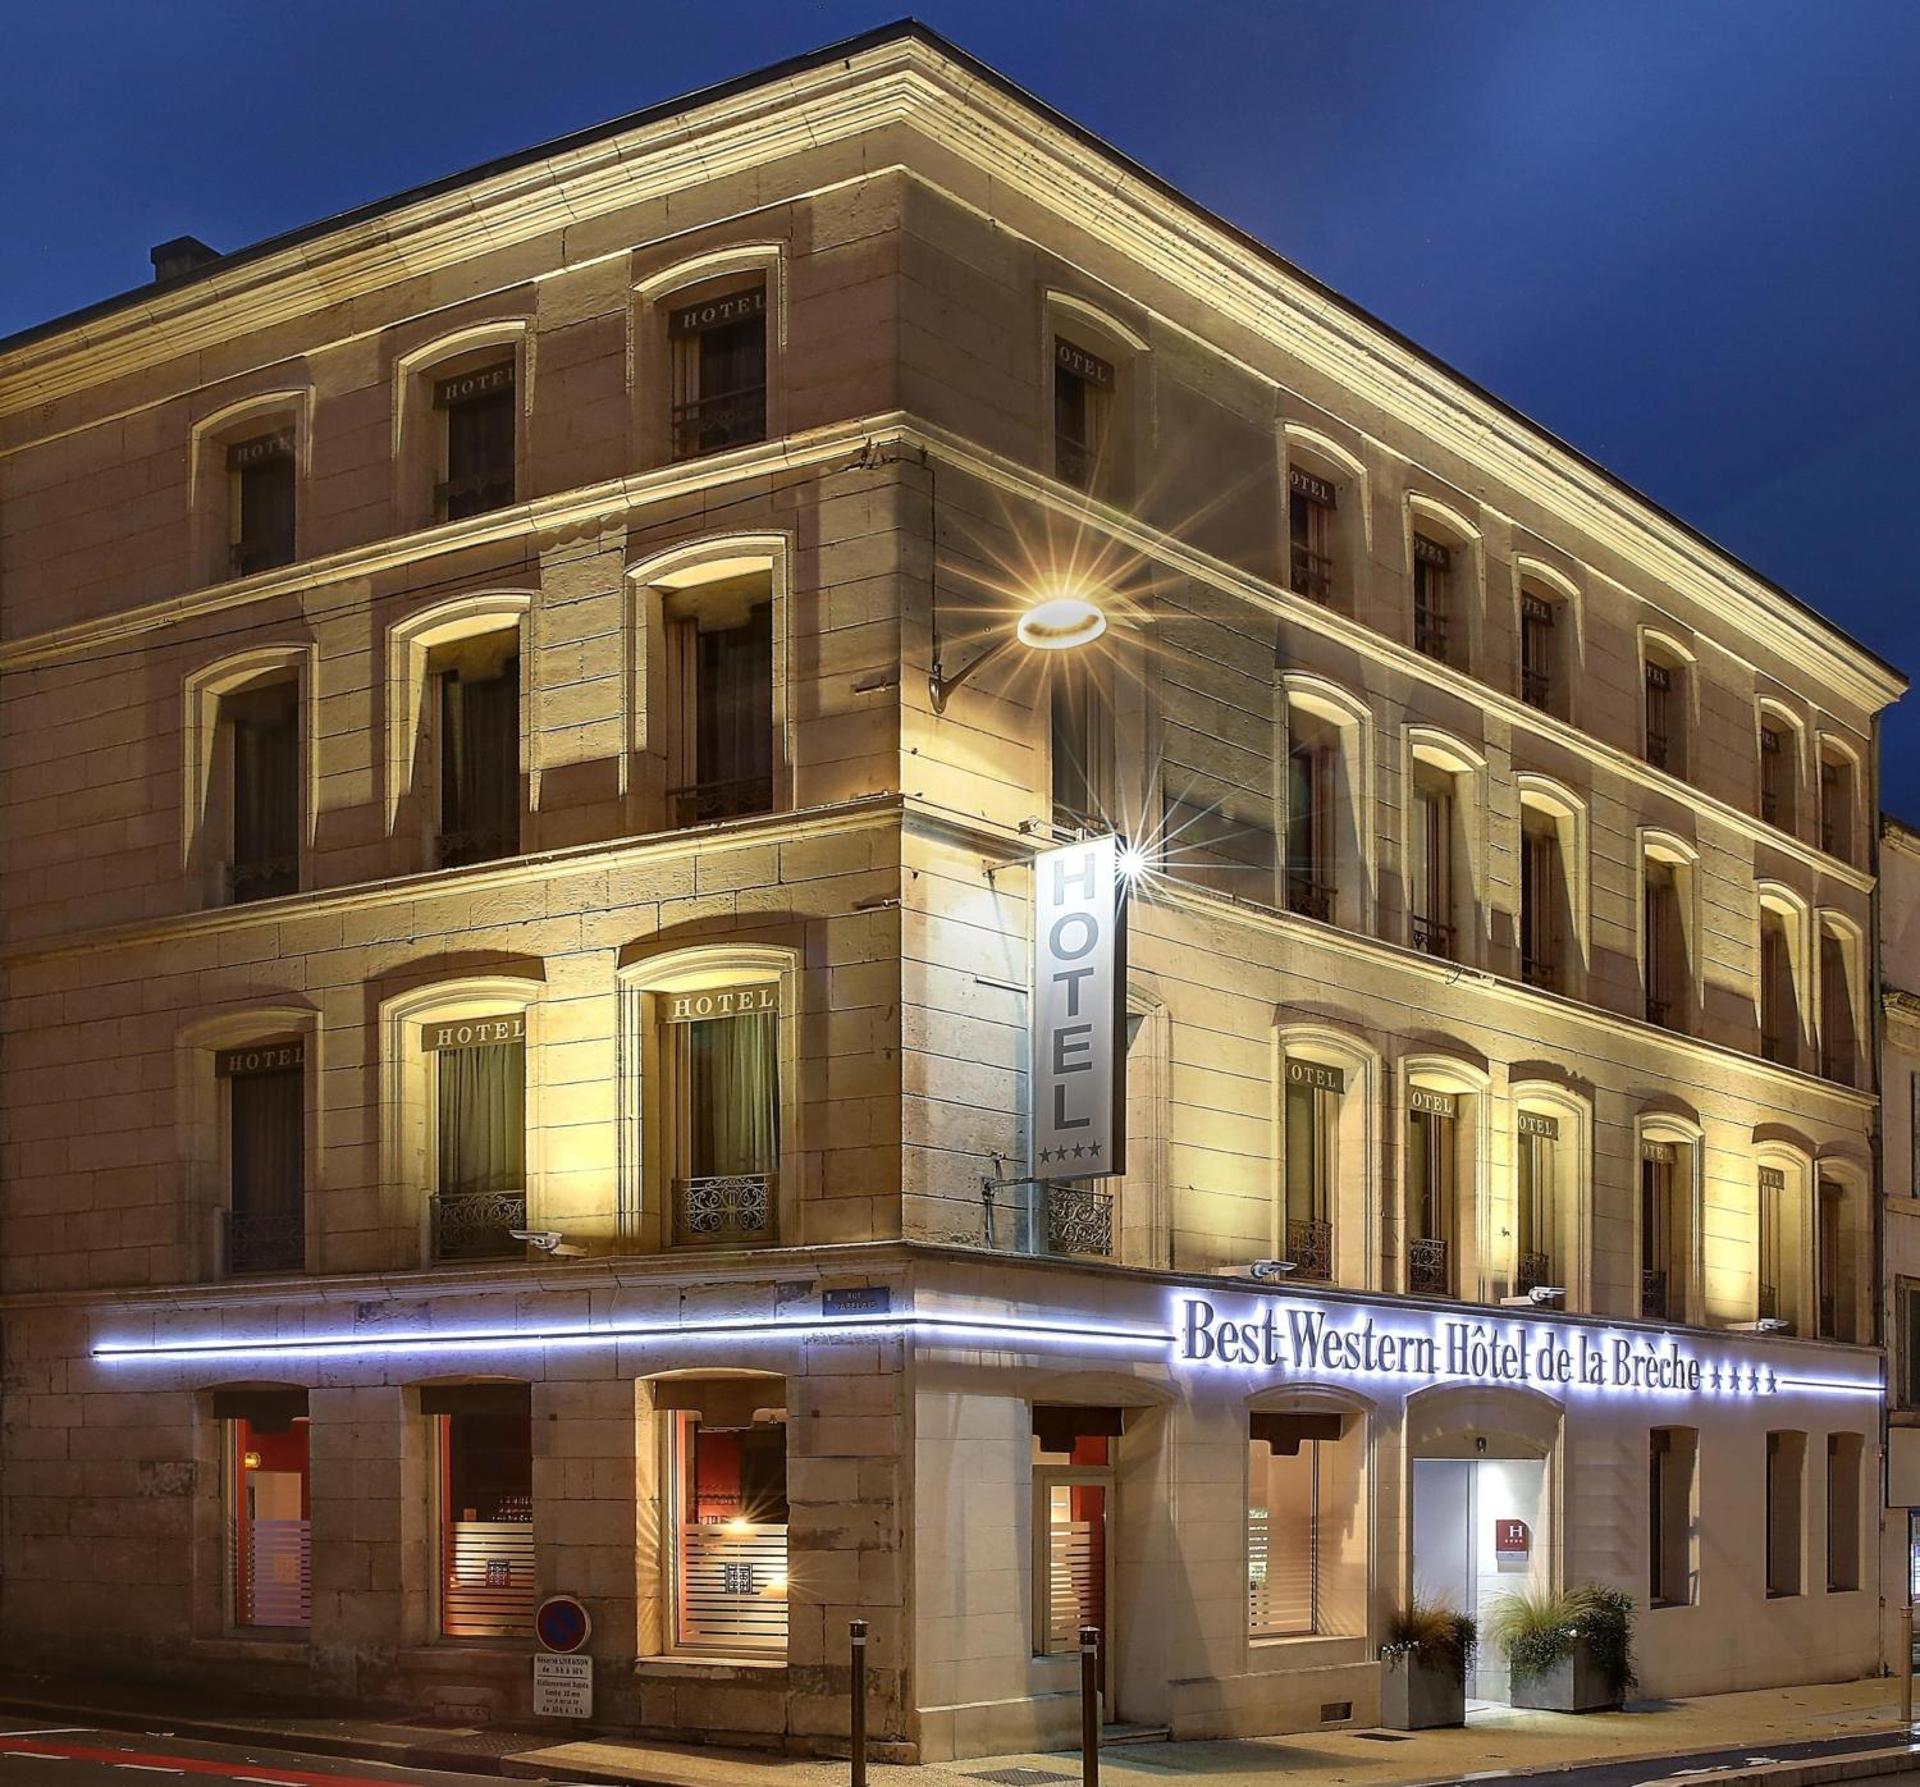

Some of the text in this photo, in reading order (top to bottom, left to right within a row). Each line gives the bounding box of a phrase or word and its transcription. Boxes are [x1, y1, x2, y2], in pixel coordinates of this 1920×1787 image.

[1060, 345, 1107, 382] OTEL
[1289, 470, 1329, 501] OTEL
[673, 989, 774, 1017] HOTEL
[1049, 852, 1099, 1131] HOTEL
[436, 1019, 525, 1046] HOTEL
[228, 1047, 304, 1071] HOTEL
[1291, 1064, 1336, 1088] OTEL
[1412, 1091, 1451, 1113] OTEL
[1518, 1115, 1552, 1135] OTEL
[1183, 1299, 1701, 1391] Best Western Hôtel de la Brèche
[1509, 1525, 1523, 1537] H
